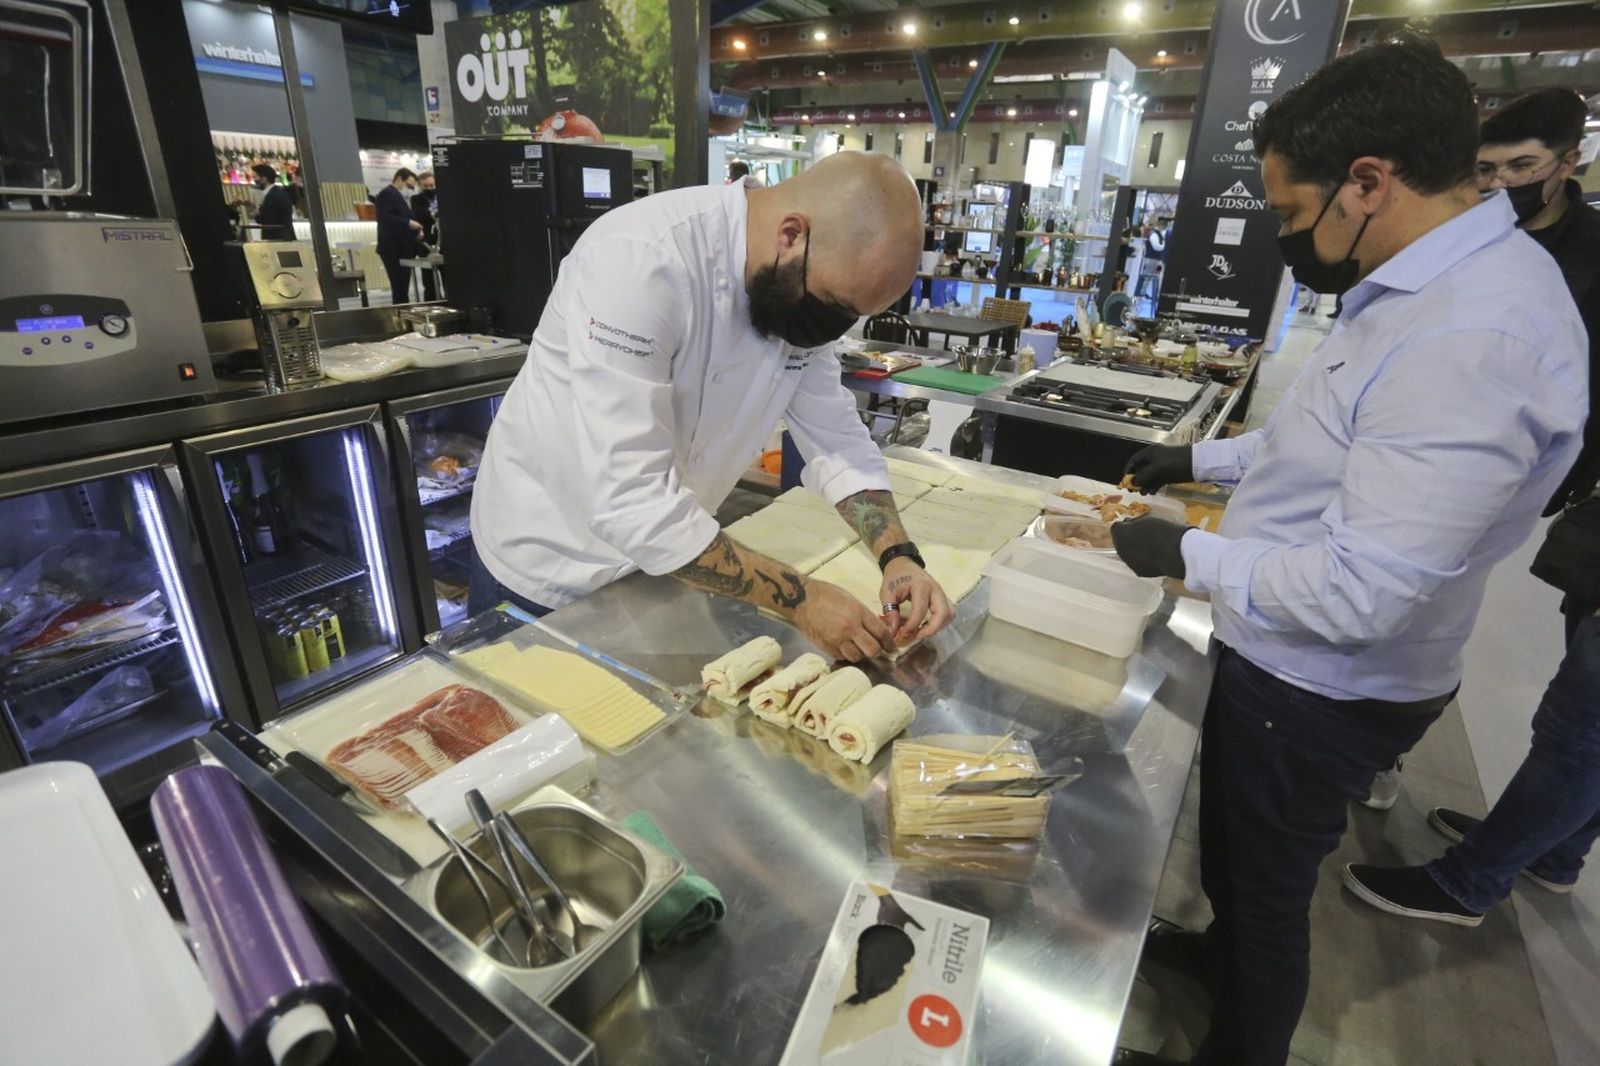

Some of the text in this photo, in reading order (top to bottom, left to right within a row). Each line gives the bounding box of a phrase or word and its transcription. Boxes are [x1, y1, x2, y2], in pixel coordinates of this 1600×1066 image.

[202, 42, 282, 68] winterhalte
[1250, 79, 1276, 90] RAK
[486, 104, 529, 117] COMPANY
[1212, 153, 1247, 164] COSTA
[1205, 196, 1266, 210] DUDSON
[102, 226, 174, 243] MISTRAL
[1190, 295, 1240, 308] winterhalter
[942, 922, 970, 985] Nitrile
[920, 1006, 950, 1028] L
